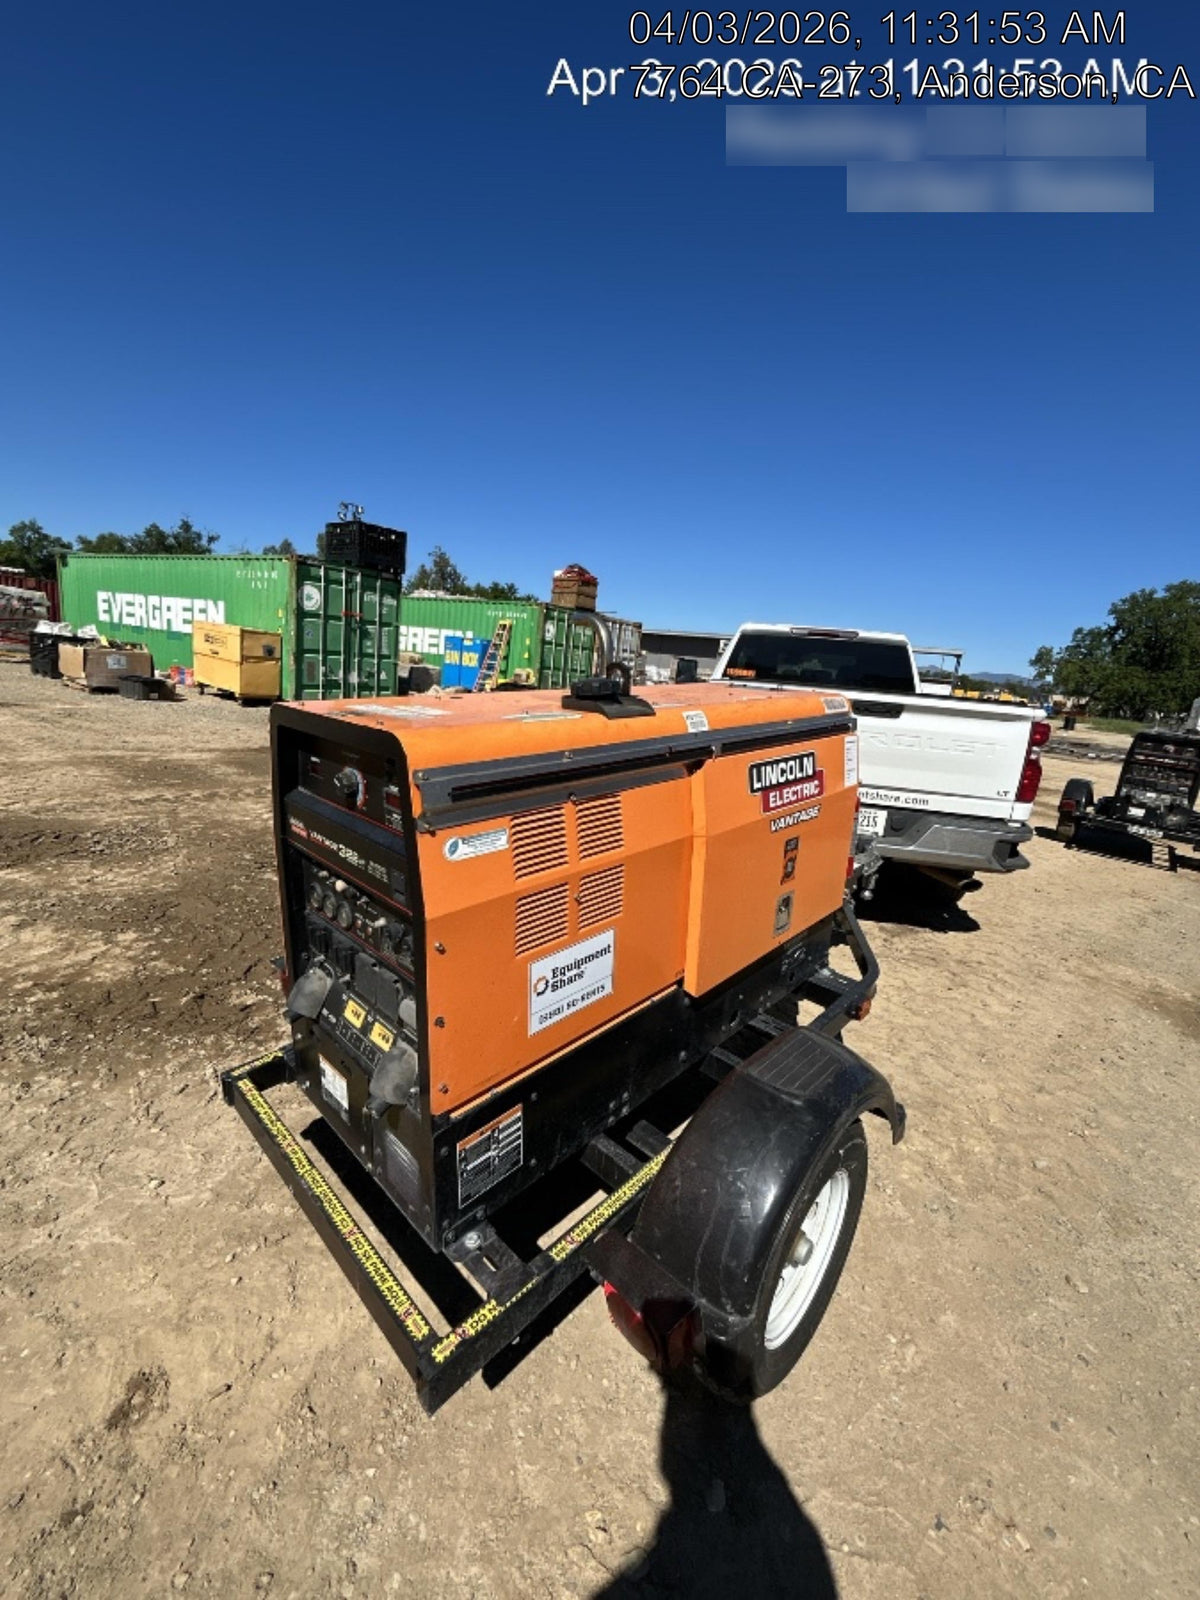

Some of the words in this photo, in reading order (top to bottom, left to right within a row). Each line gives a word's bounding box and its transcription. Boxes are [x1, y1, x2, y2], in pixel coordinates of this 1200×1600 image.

[97, 591, 225, 633] EVERGREEN
[752, 756, 814, 790] LINCOLN
[769, 780, 820, 808] ELECTRIC
[770, 806, 820, 833] VANTAGE
[551, 943, 612, 980] Equipment
[550, 970, 585, 993] Share
